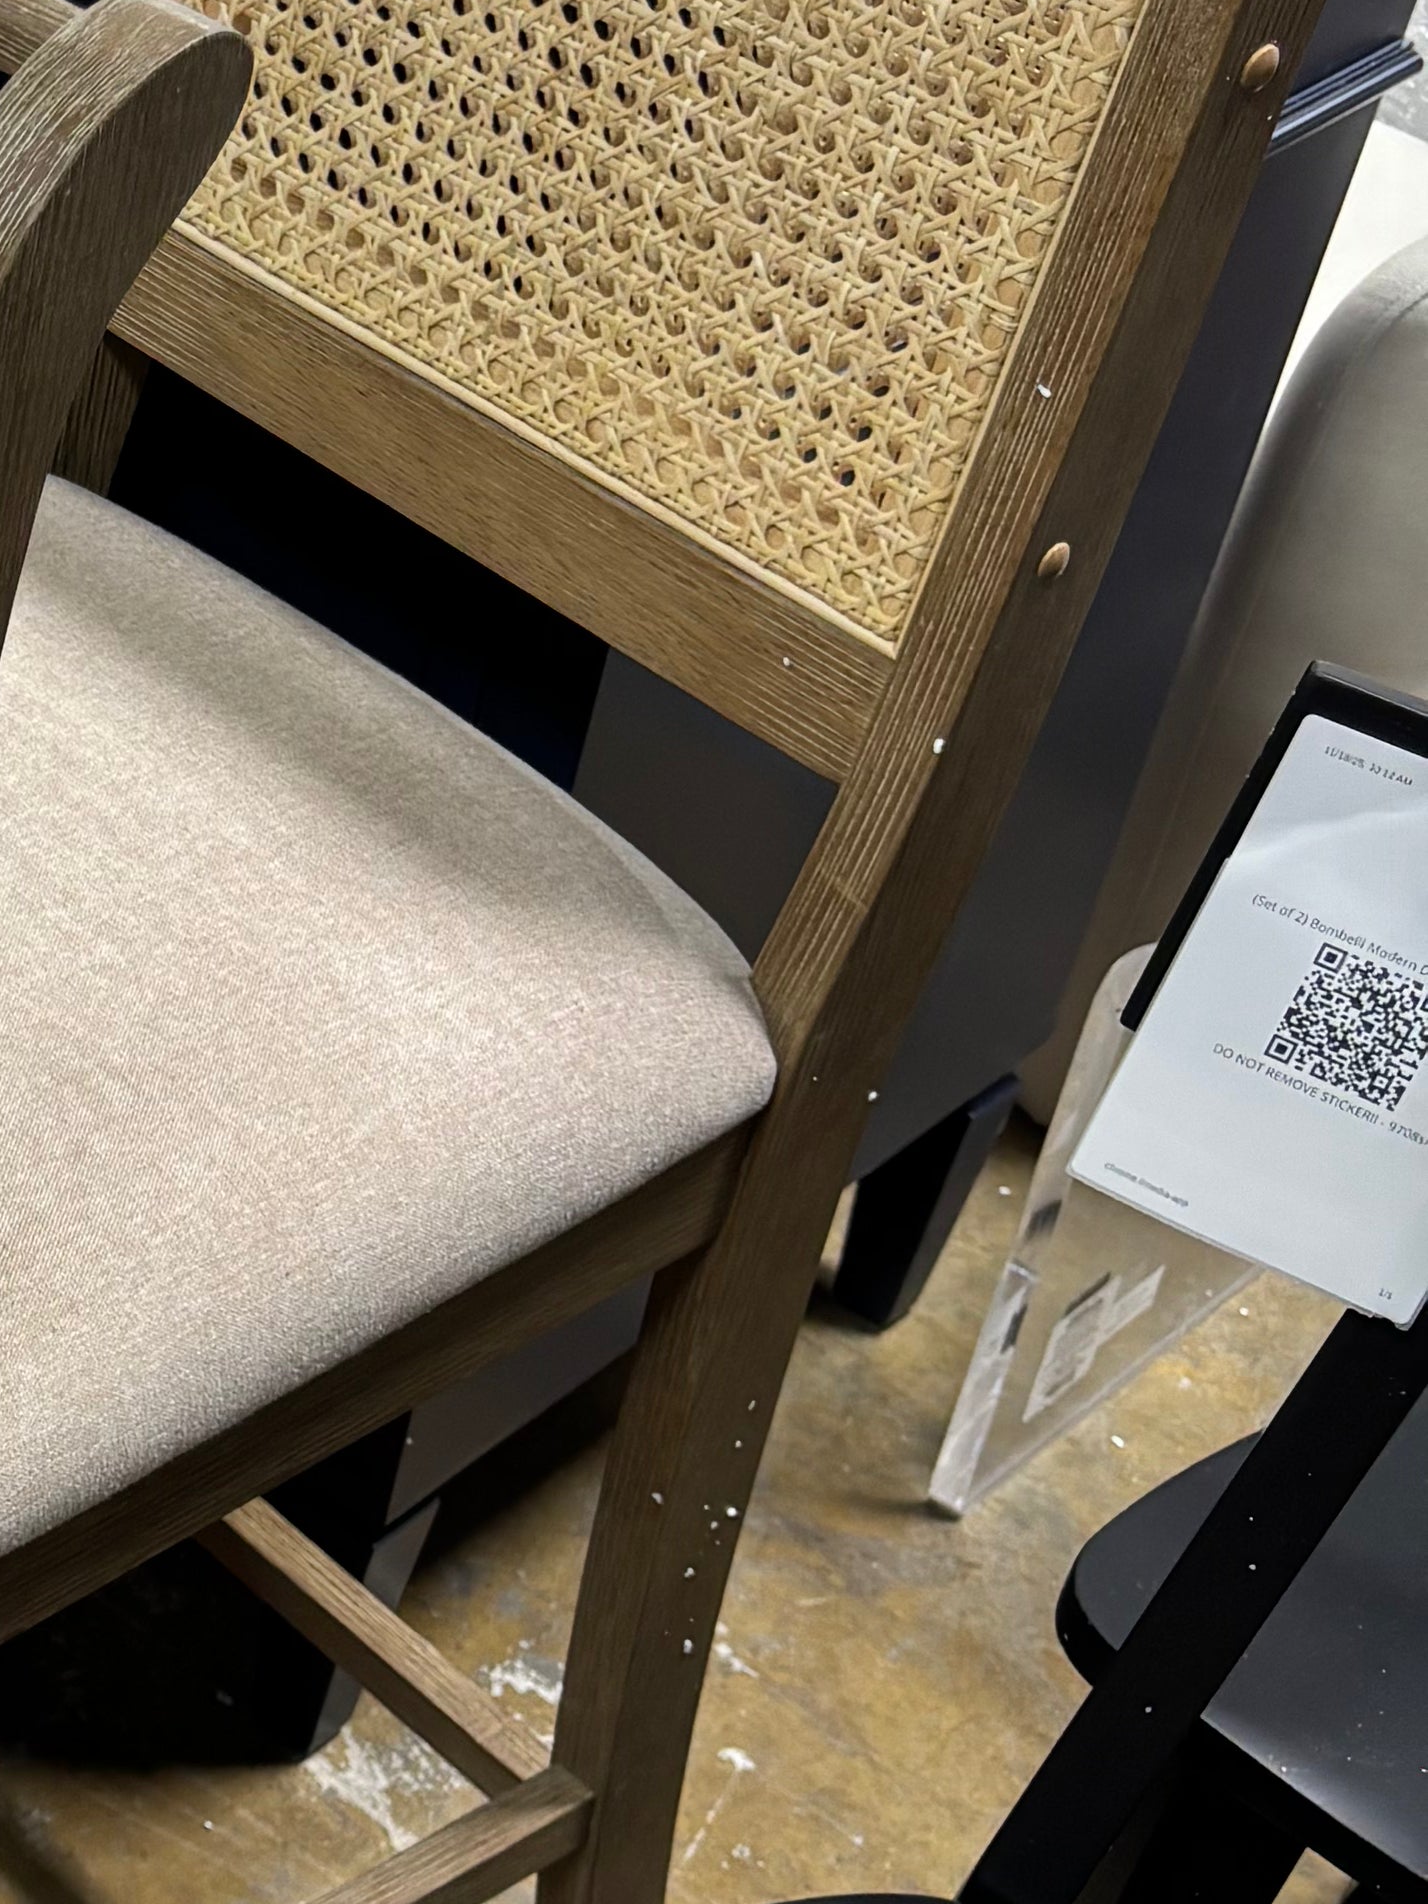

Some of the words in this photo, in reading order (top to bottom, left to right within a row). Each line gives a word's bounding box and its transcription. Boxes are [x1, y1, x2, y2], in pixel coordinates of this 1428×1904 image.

[1252, 894, 1277, 912] (Set
[1279, 907, 1296, 918] of
[1295, 911, 1309, 926] 2)
[1367, 943, 1418, 973] Modern
[1213, 1042, 1234, 1060] DO
[1235, 1053, 1265, 1073] NOT
[1265, 1066, 1319, 1098] REMOVE
